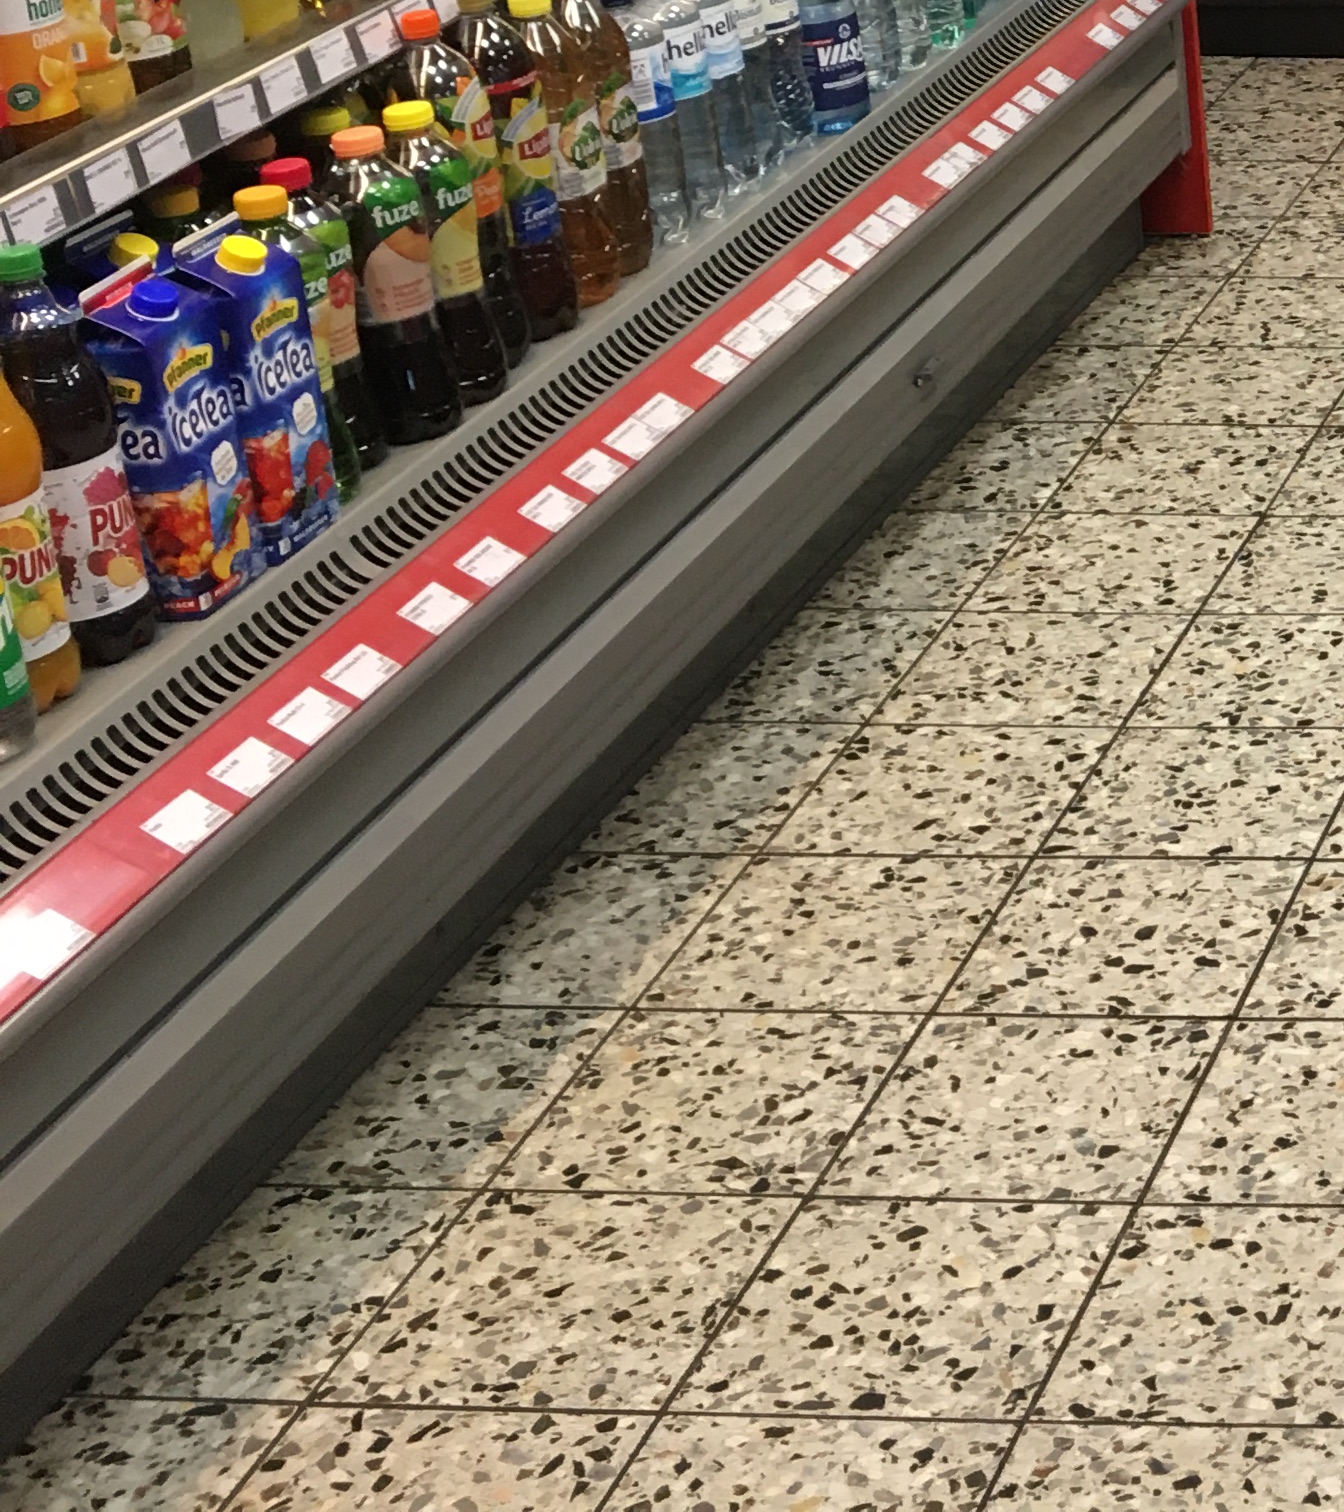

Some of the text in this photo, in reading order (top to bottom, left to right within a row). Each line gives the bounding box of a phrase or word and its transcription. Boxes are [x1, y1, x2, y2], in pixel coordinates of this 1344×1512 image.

[32, 28, 70, 50] ORAN
[702, 13, 737, 39] hell
[667, 30, 701, 58] hell
[815, 40, 864, 67] VILS
[371, 199, 420, 229] fuze
[435, 187, 473, 212] fuz
[254, 303, 299, 339] pfanner
[163, 350, 211, 387] pfanner
[89, 504, 135, 546] PUN
[1, 546, 57, 585] PUN
